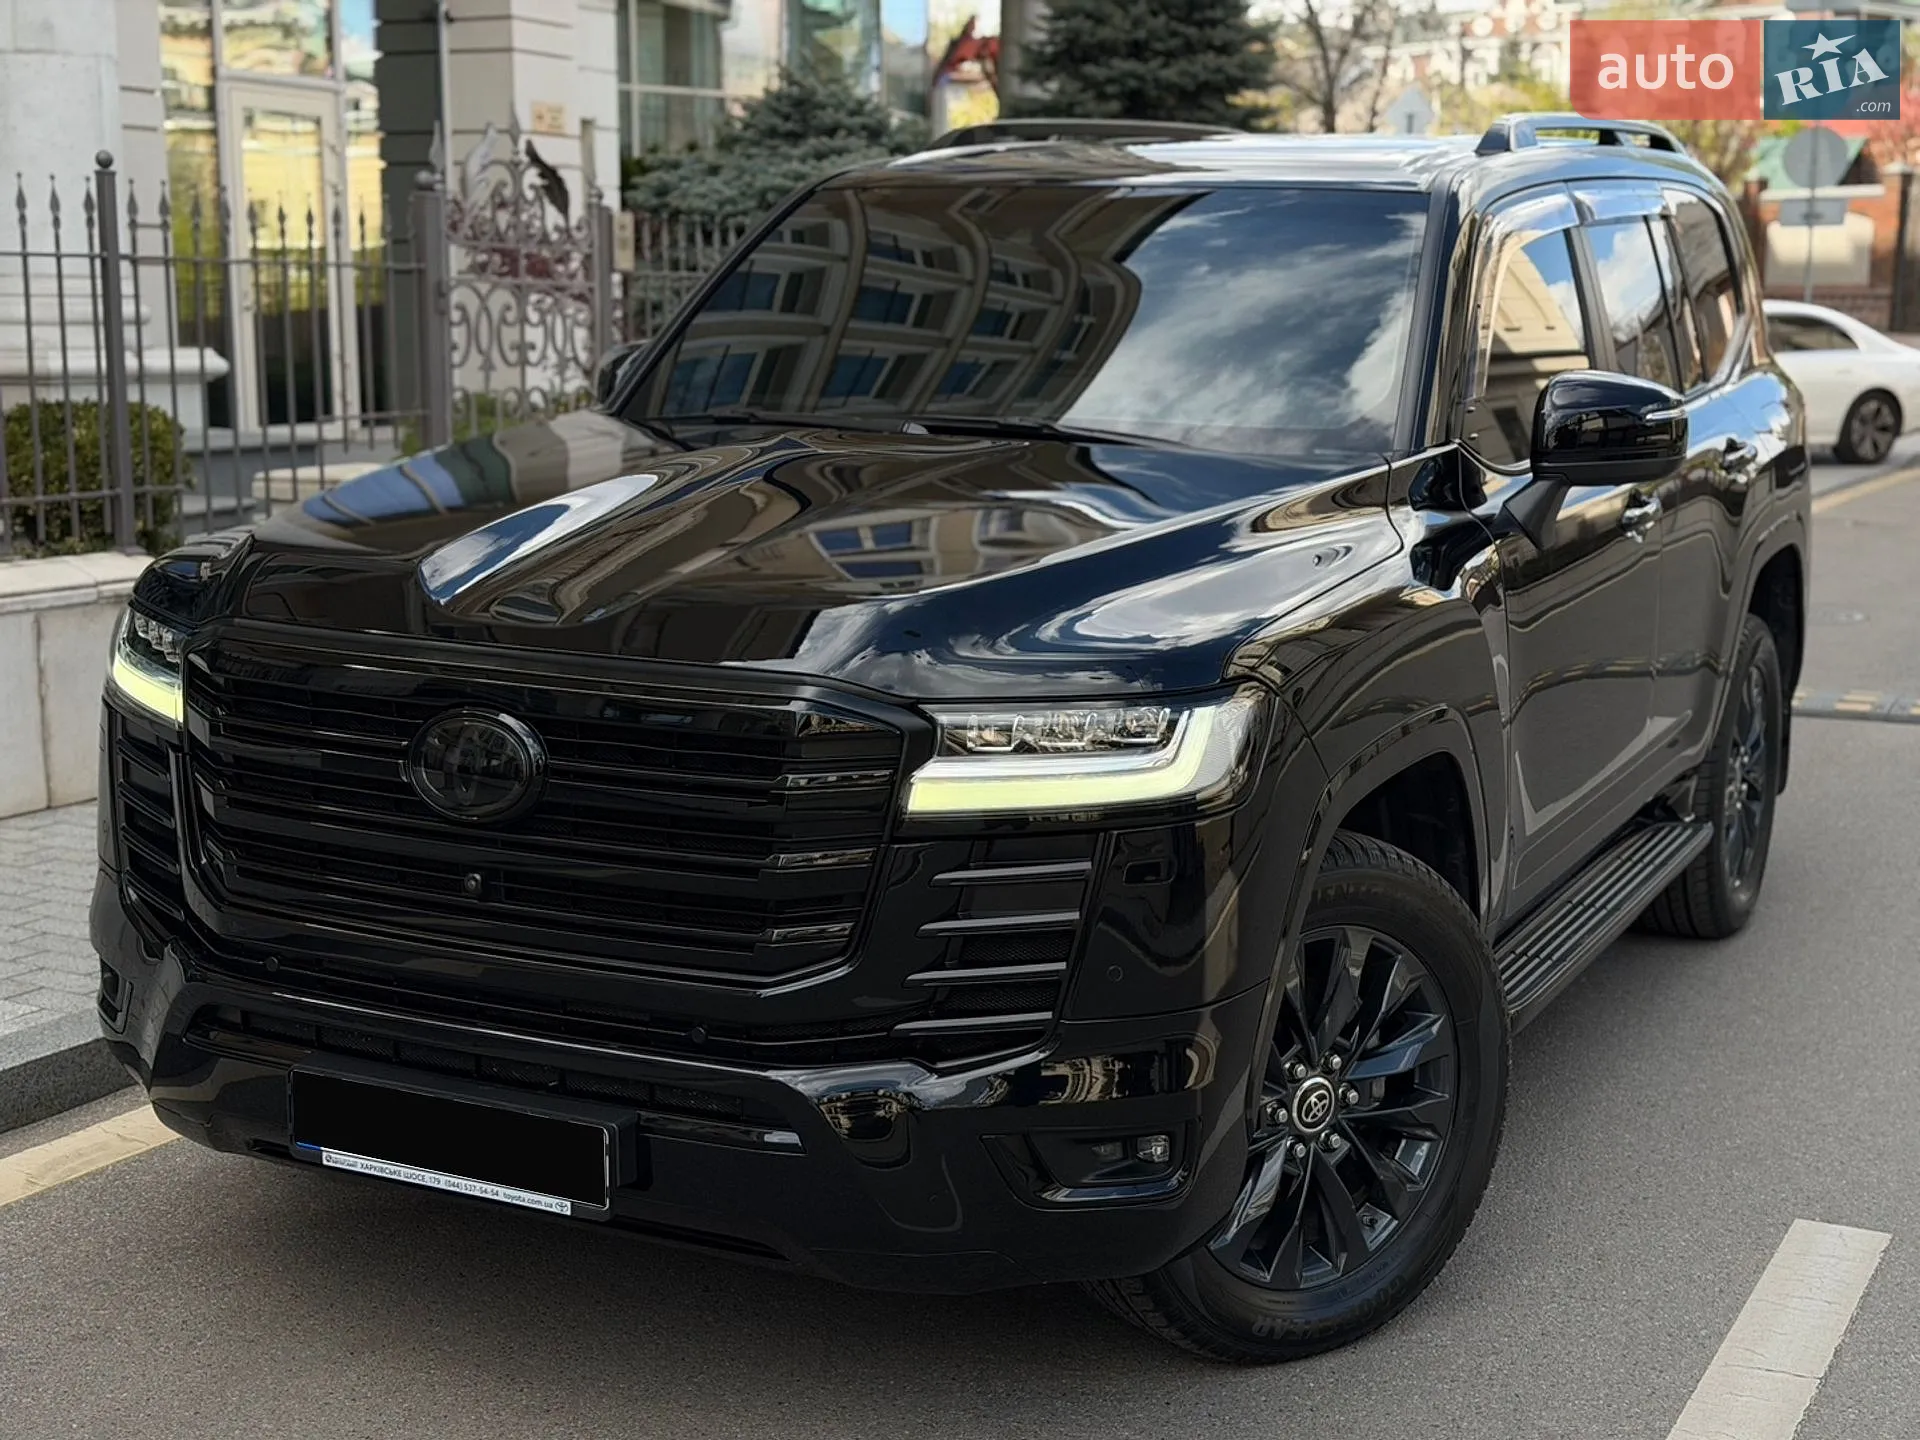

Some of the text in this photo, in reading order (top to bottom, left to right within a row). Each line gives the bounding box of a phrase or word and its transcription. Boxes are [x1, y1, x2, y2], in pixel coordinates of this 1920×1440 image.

[360, 1163, 402, 1178] ХАРКІВСЬКЕ
[444, 1178, 463, 1191] (044)
[463, 1184, 499, 1197] 537-54-54
